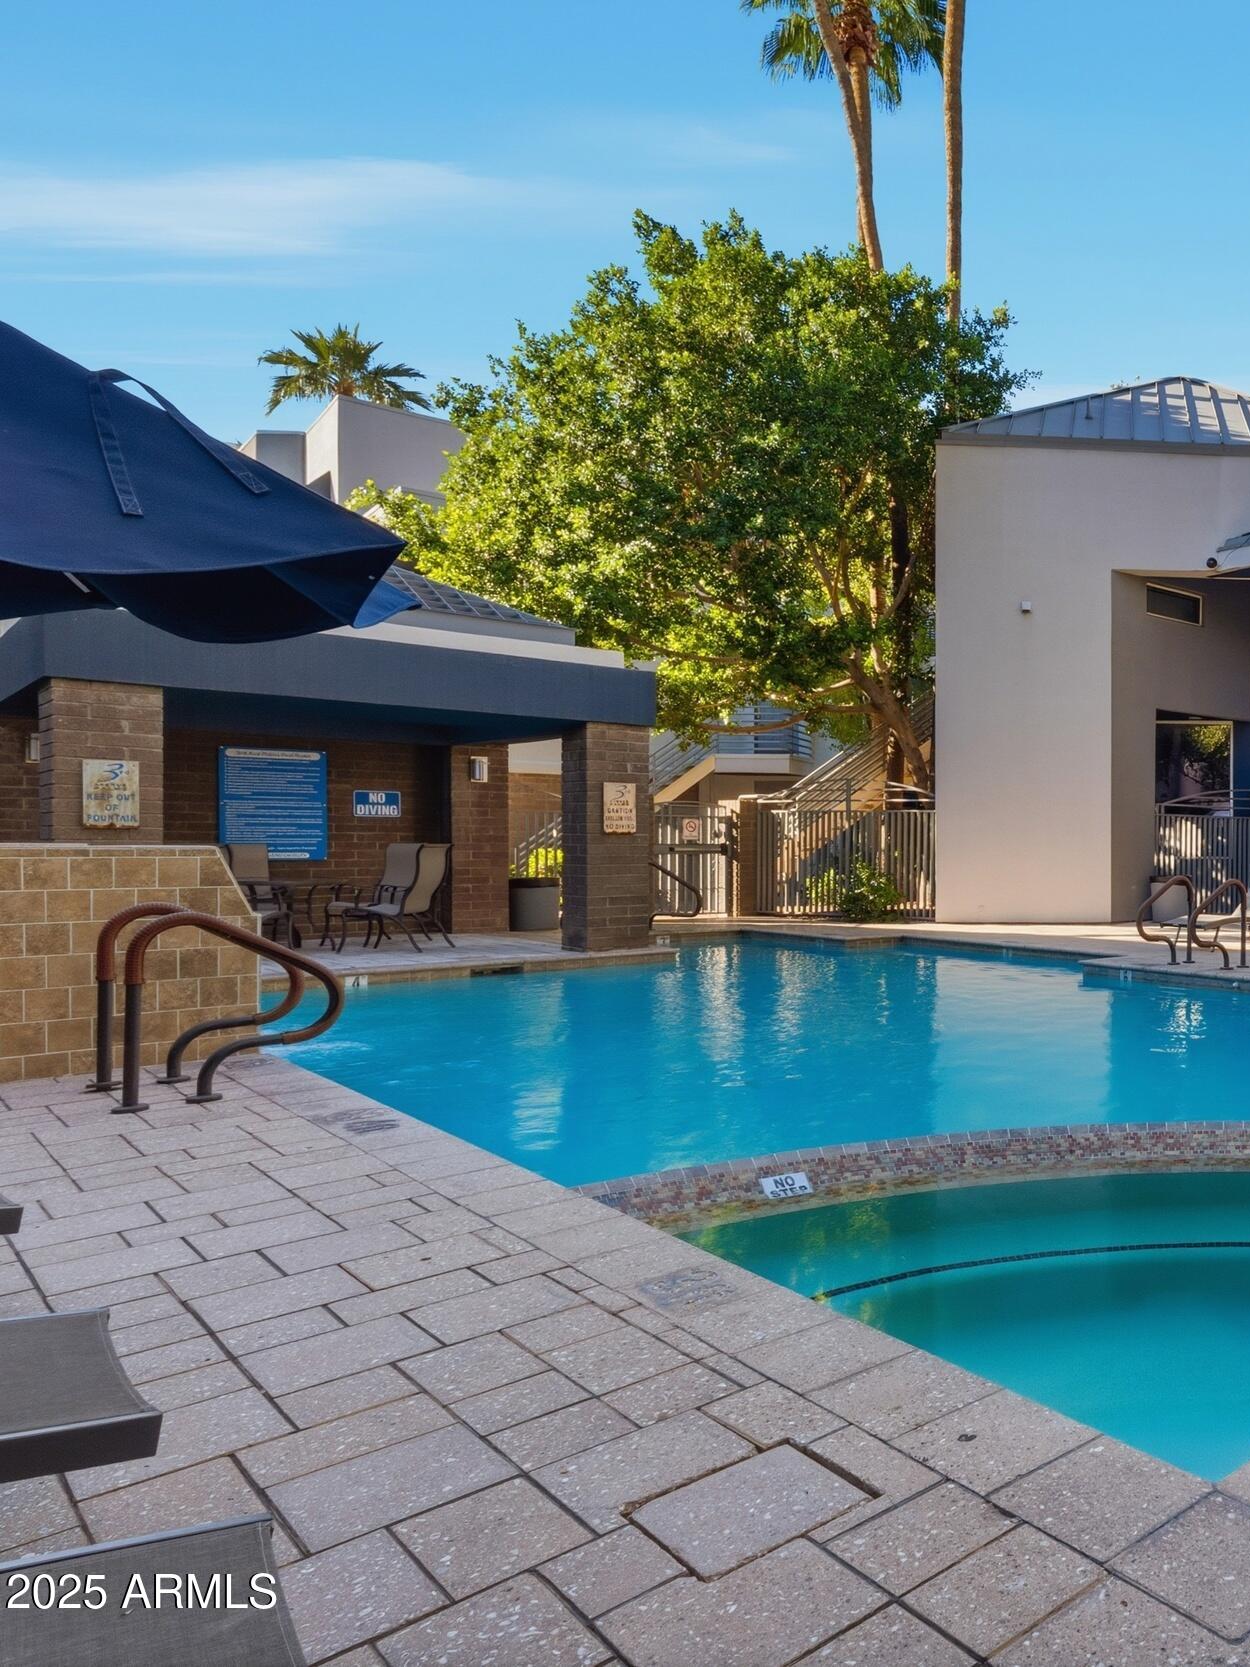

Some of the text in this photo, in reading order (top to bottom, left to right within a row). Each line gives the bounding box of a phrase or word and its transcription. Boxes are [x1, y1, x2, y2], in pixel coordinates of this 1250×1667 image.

[86, 793, 113, 801] KEEP
[369, 793, 385, 804] NO
[105, 804, 119, 812] OF
[356, 804, 398, 816] DIVING
[773, 1176, 796, 1189] NO
[770, 1185, 808, 1198] STEP
